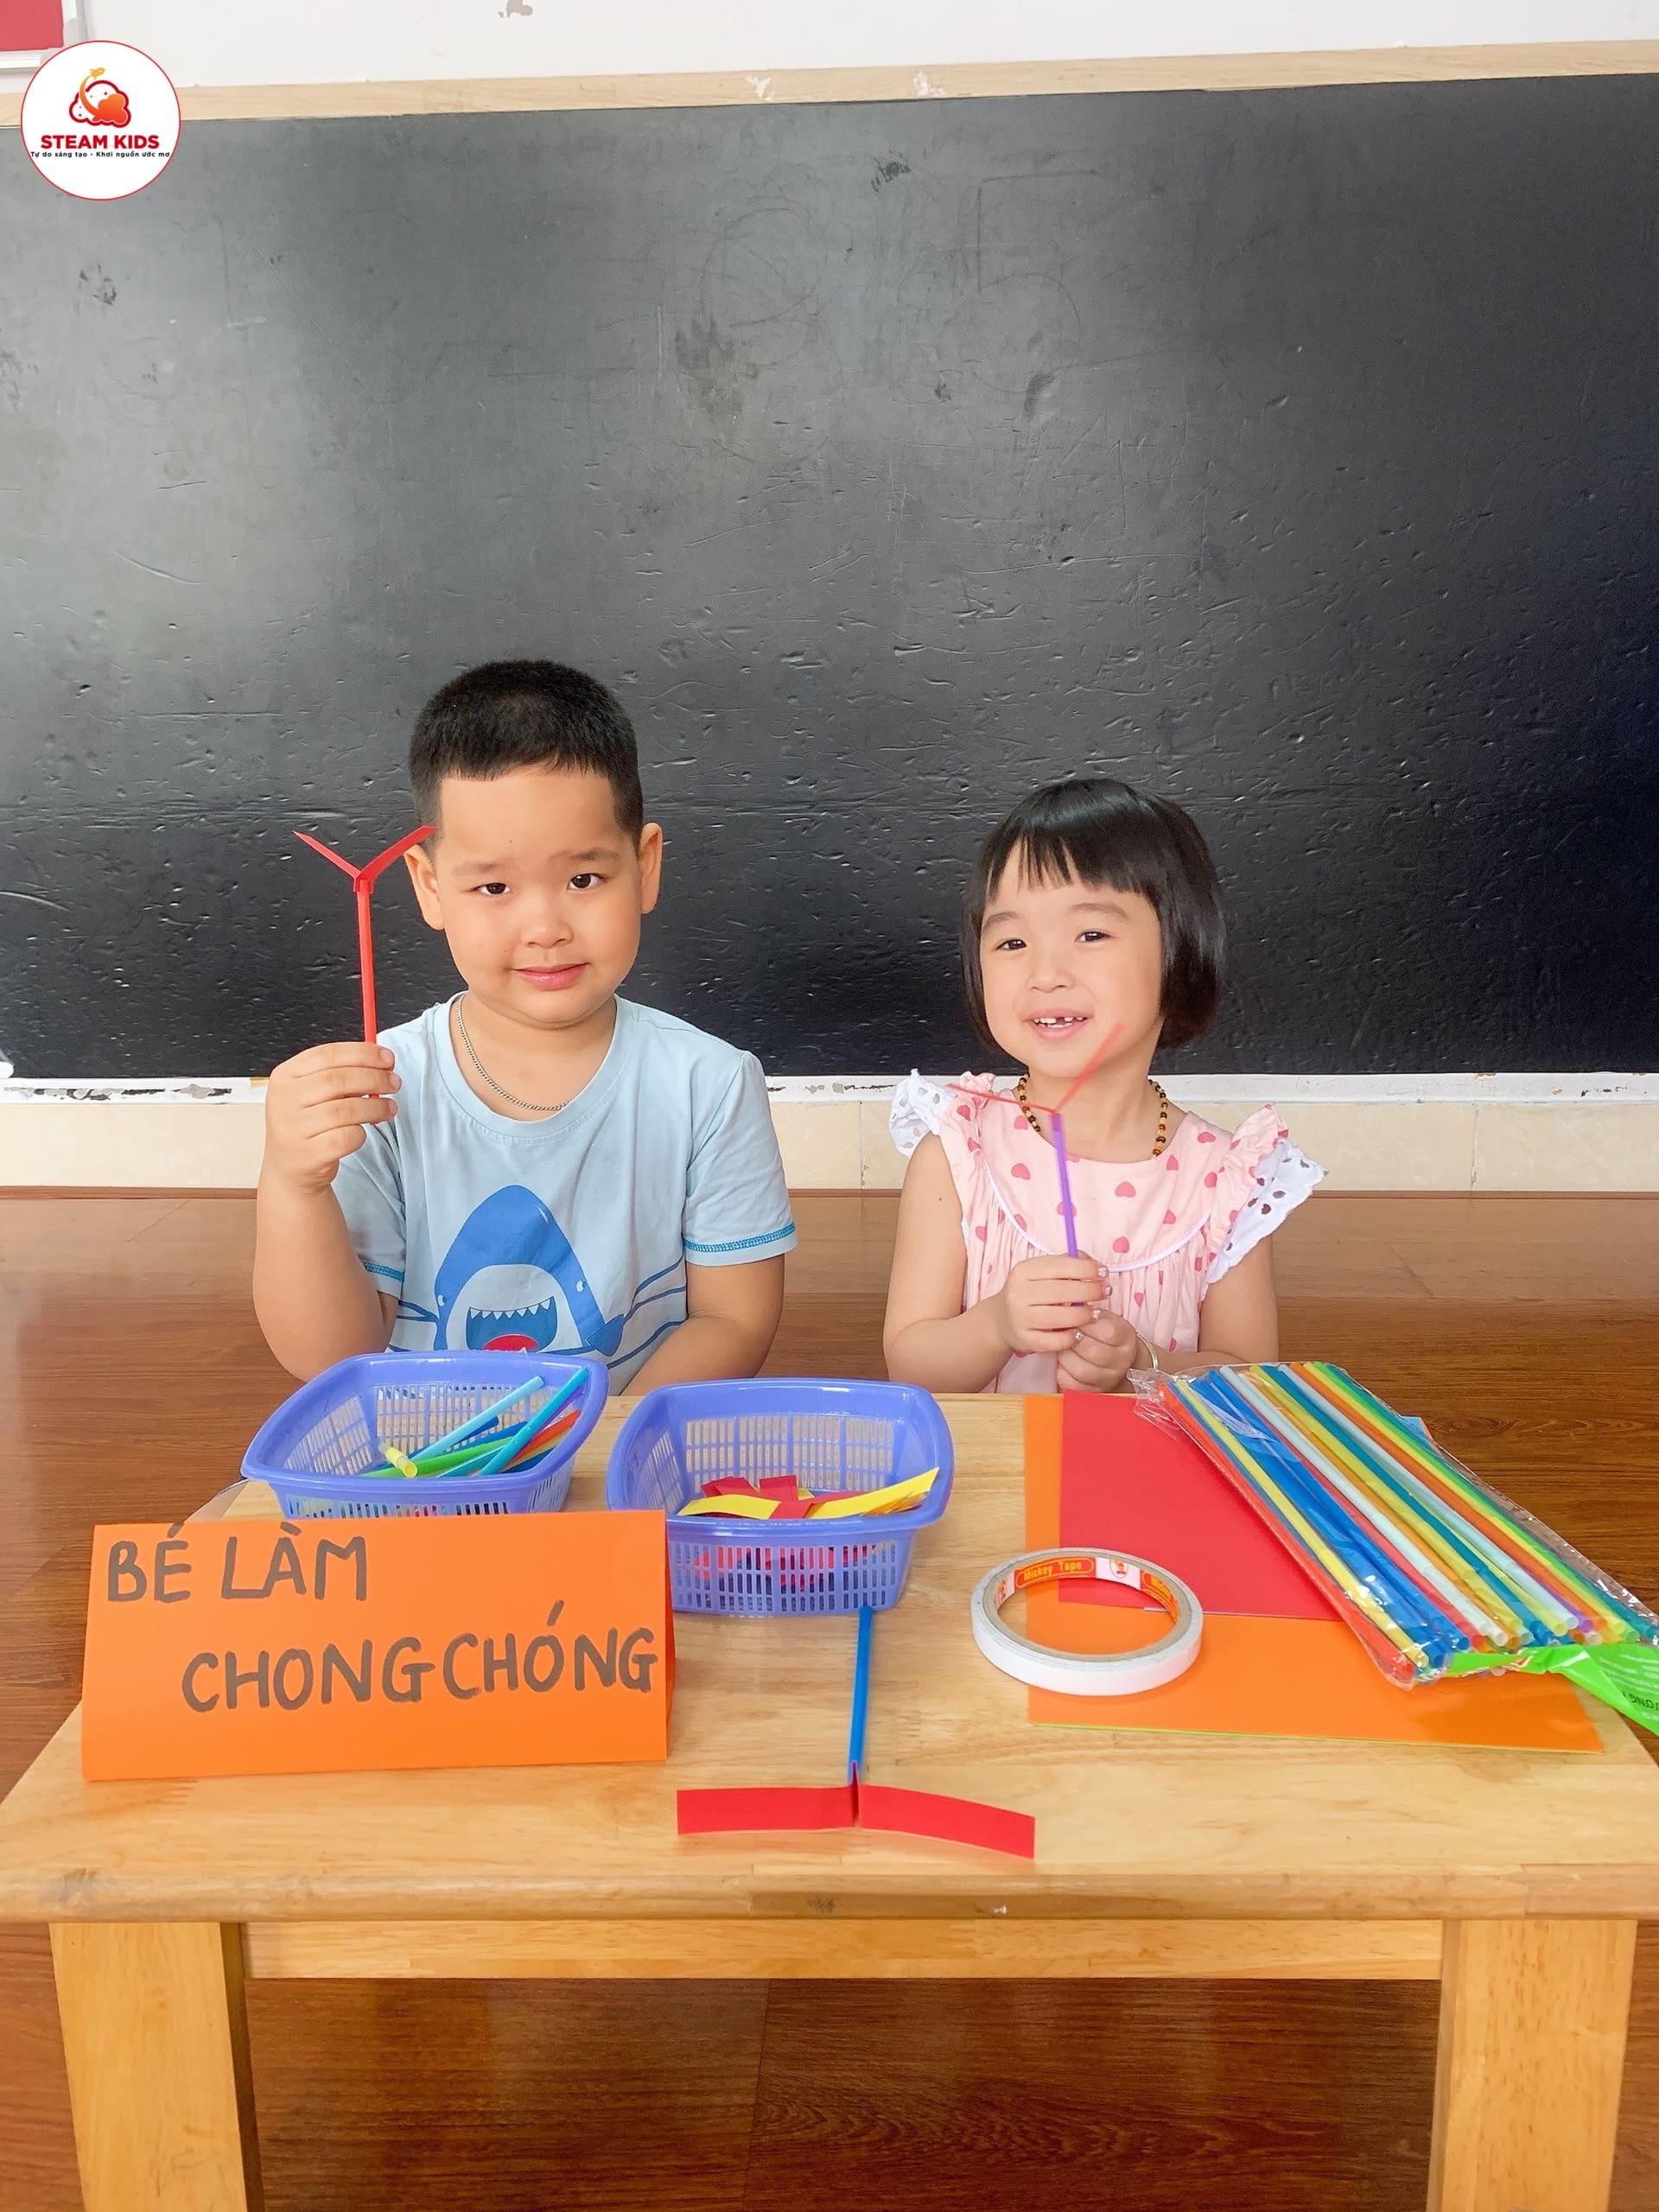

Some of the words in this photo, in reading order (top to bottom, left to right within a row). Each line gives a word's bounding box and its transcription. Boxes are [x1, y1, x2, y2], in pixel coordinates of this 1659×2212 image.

[107, 1522, 192, 1604] BÉ
[221, 1522, 366, 1600] LÀM
[1023, 1566, 1053, 1582] Mickey
[1058, 1560, 1083, 1572] Tape
[181, 1637, 435, 1713] CHONG
[442, 1599, 658, 1700] CHÓNG
